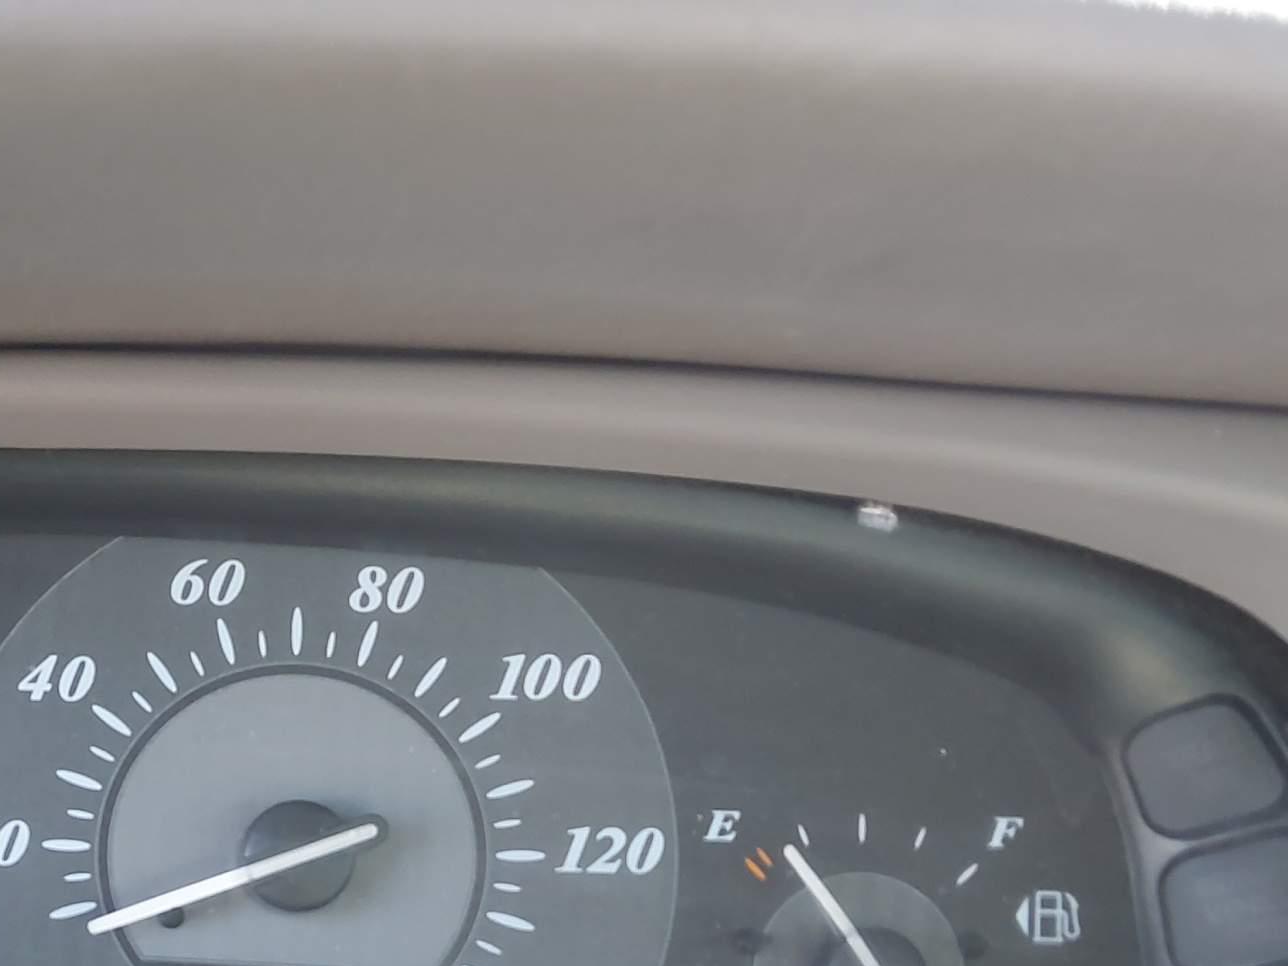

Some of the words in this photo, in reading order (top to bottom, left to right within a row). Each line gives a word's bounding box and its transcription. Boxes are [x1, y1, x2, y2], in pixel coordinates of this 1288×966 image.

[170, 559, 246, 605] 60
[348, 566, 424, 612] 80
[17, 655, 96, 701] 40
[489, 654, 602, 700] 100
[704, 810, 741, 841] E
[988, 816, 1024, 848] F
[554, 827, 664, 874] 120
